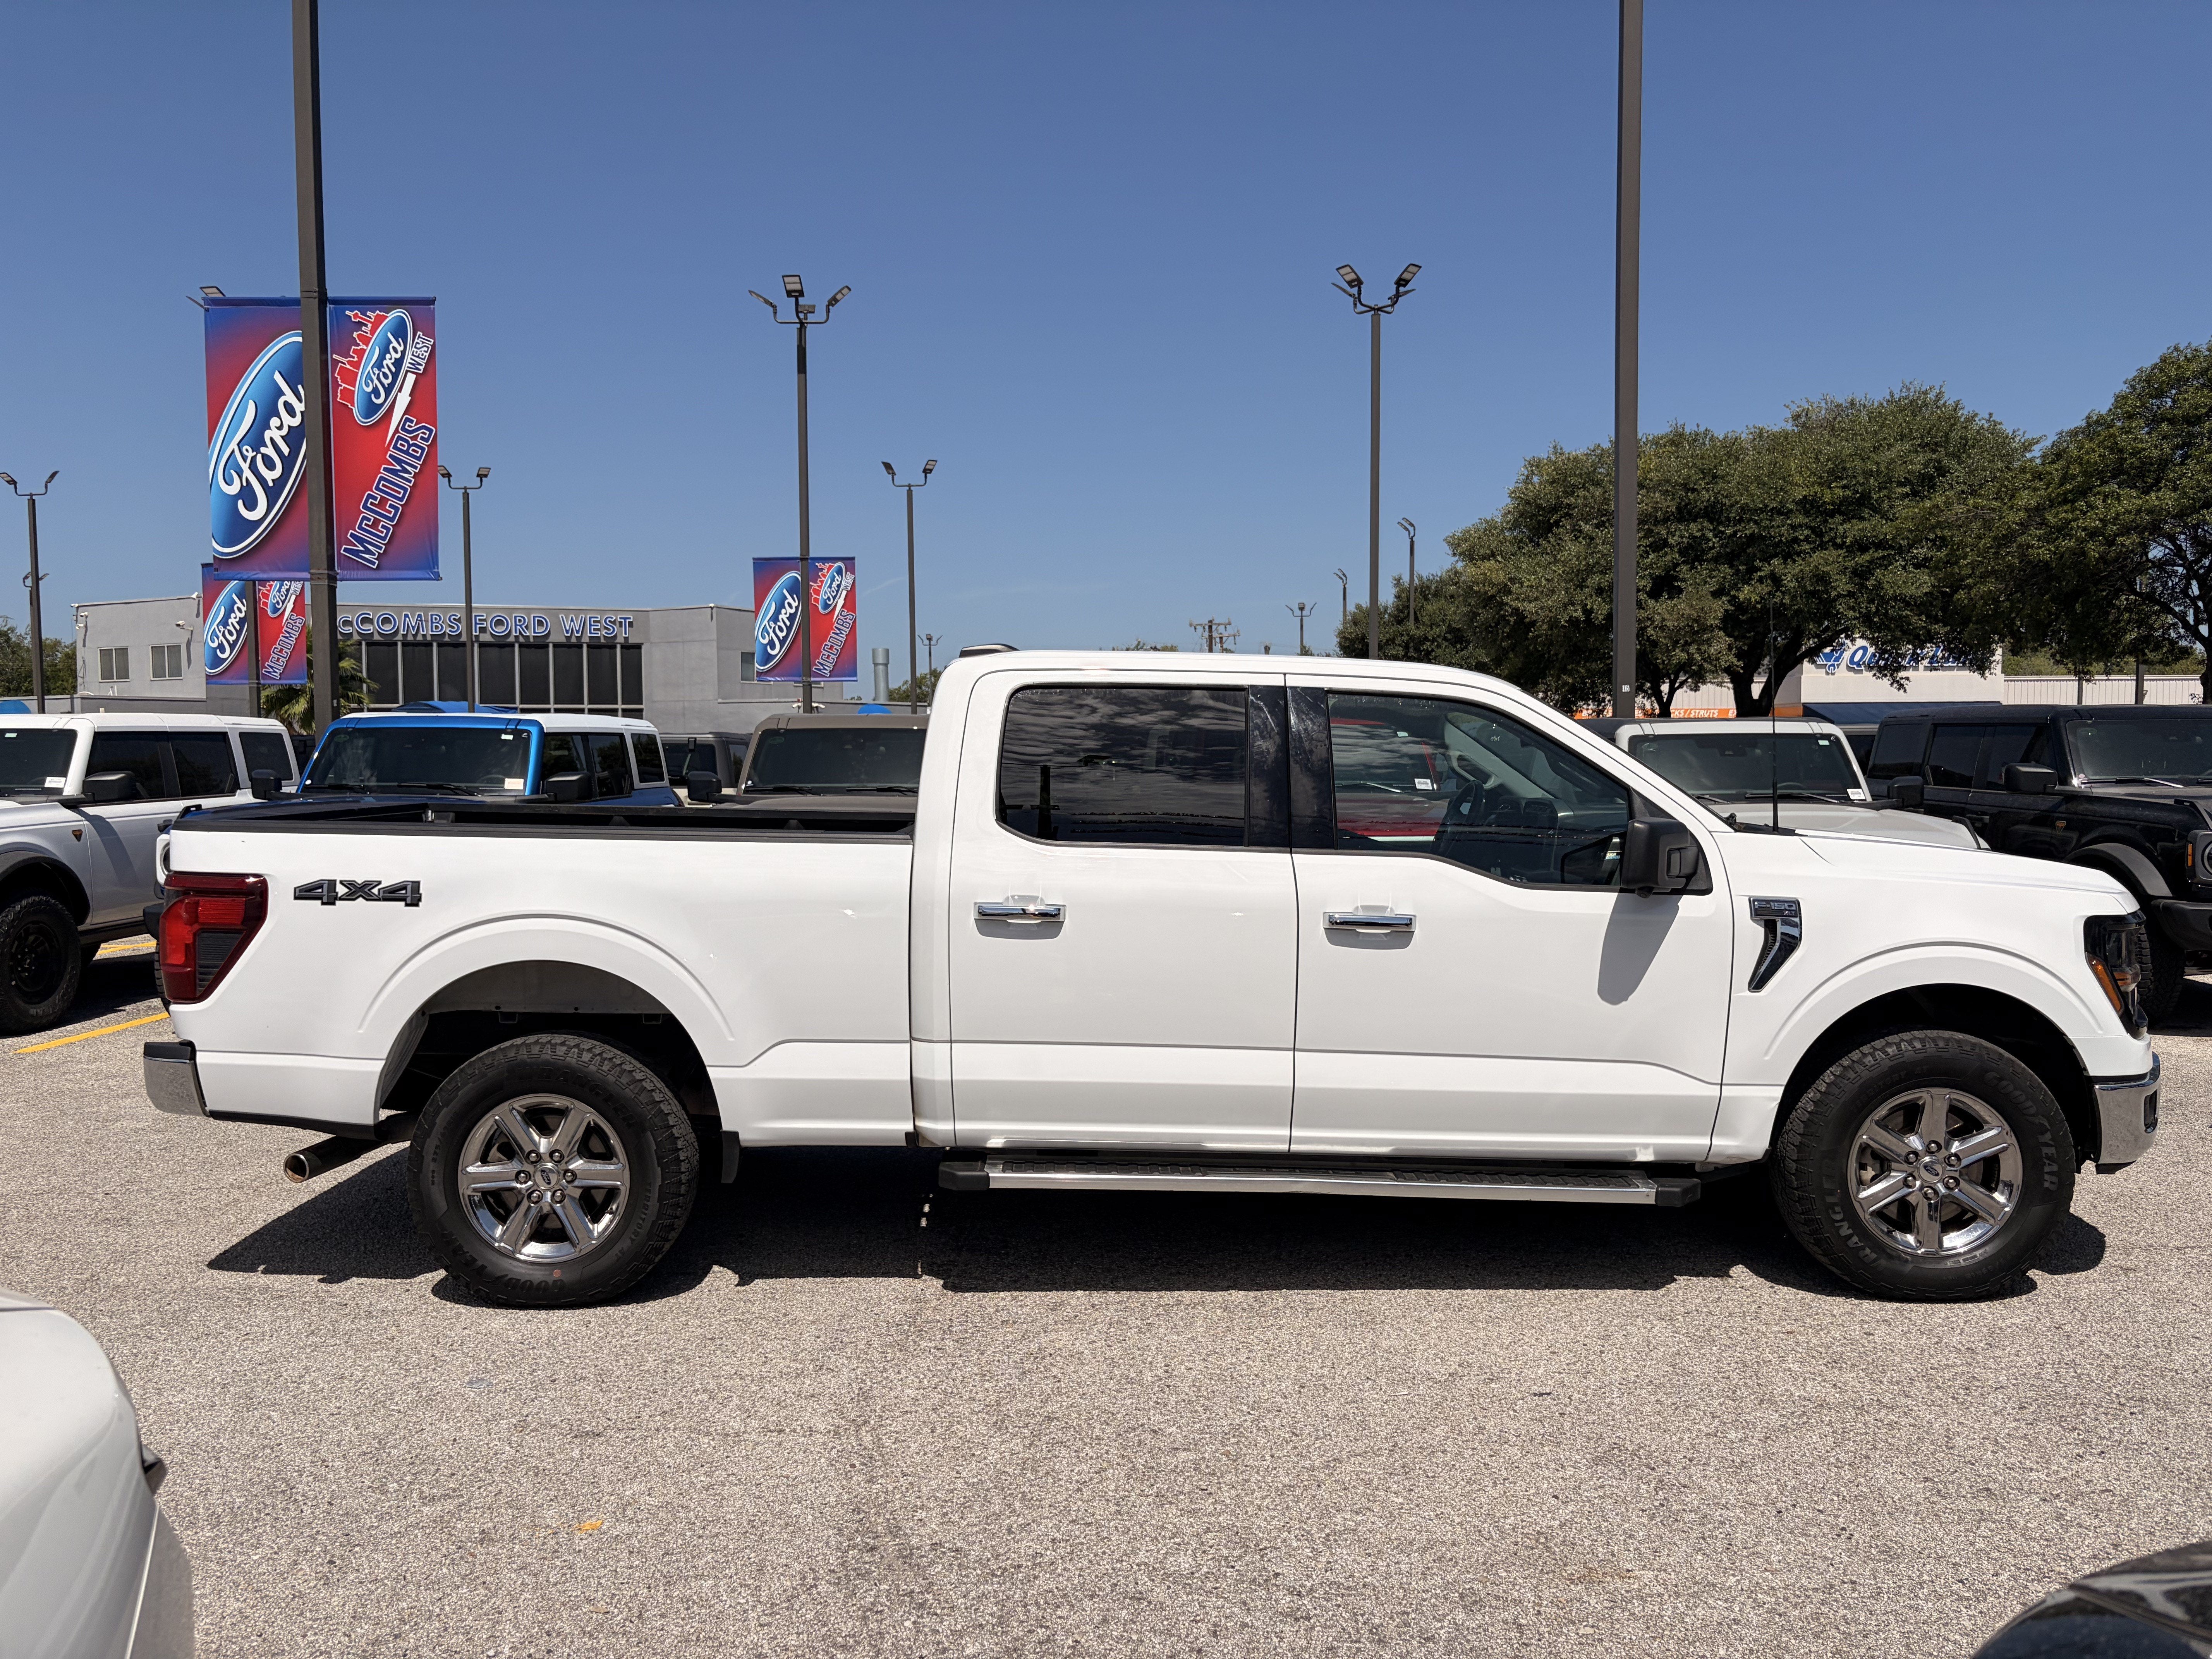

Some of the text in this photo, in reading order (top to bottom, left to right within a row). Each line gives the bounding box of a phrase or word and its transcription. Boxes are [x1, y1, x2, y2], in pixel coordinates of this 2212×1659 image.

[362, 331, 404, 404] Ford
[406, 332, 434, 374] WEST
[218, 370, 305, 521] Ford
[823, 572, 841, 604] Ford
[842, 572, 855, 591] WEST
[208, 593, 247, 658] Ford
[337, 611, 633, 637] cCOMBS FORD WEST
[758, 588, 799, 655] Ford
